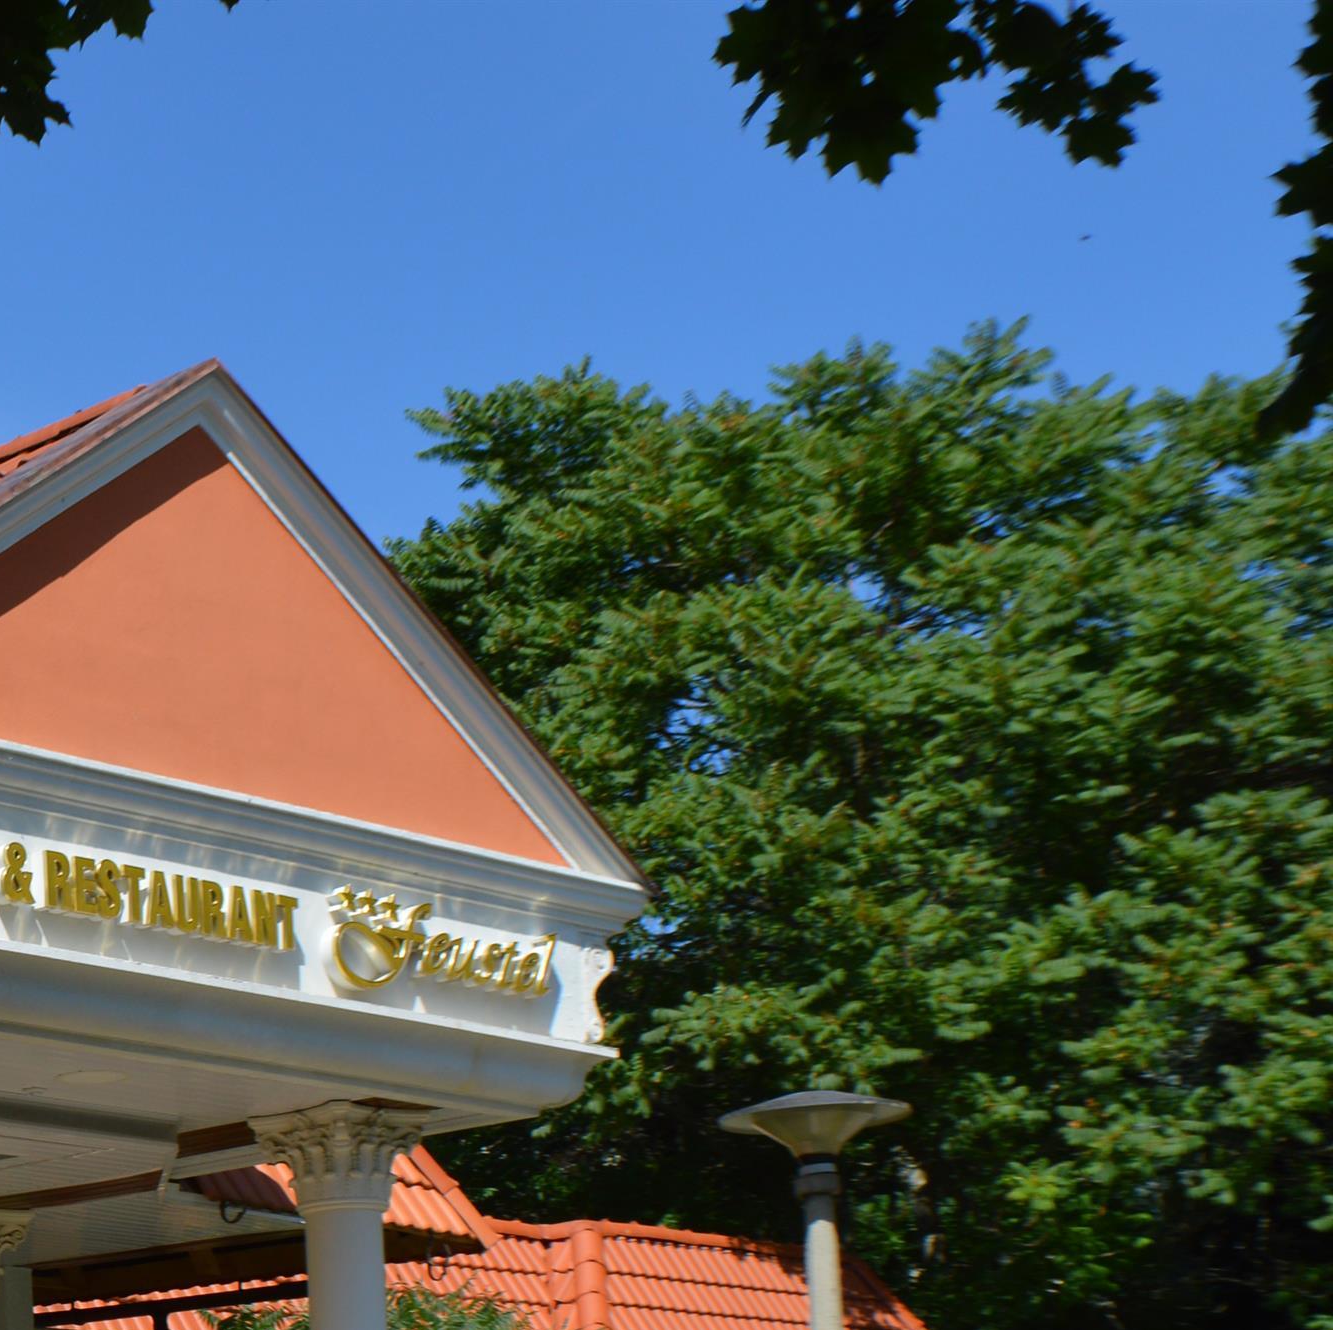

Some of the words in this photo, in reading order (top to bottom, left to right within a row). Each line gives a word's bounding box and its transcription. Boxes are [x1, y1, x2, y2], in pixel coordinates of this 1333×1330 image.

[0, 842, 35, 904] &
[43, 849, 299, 951] RESTAURANT
[332, 902, 557, 995] Feustel
